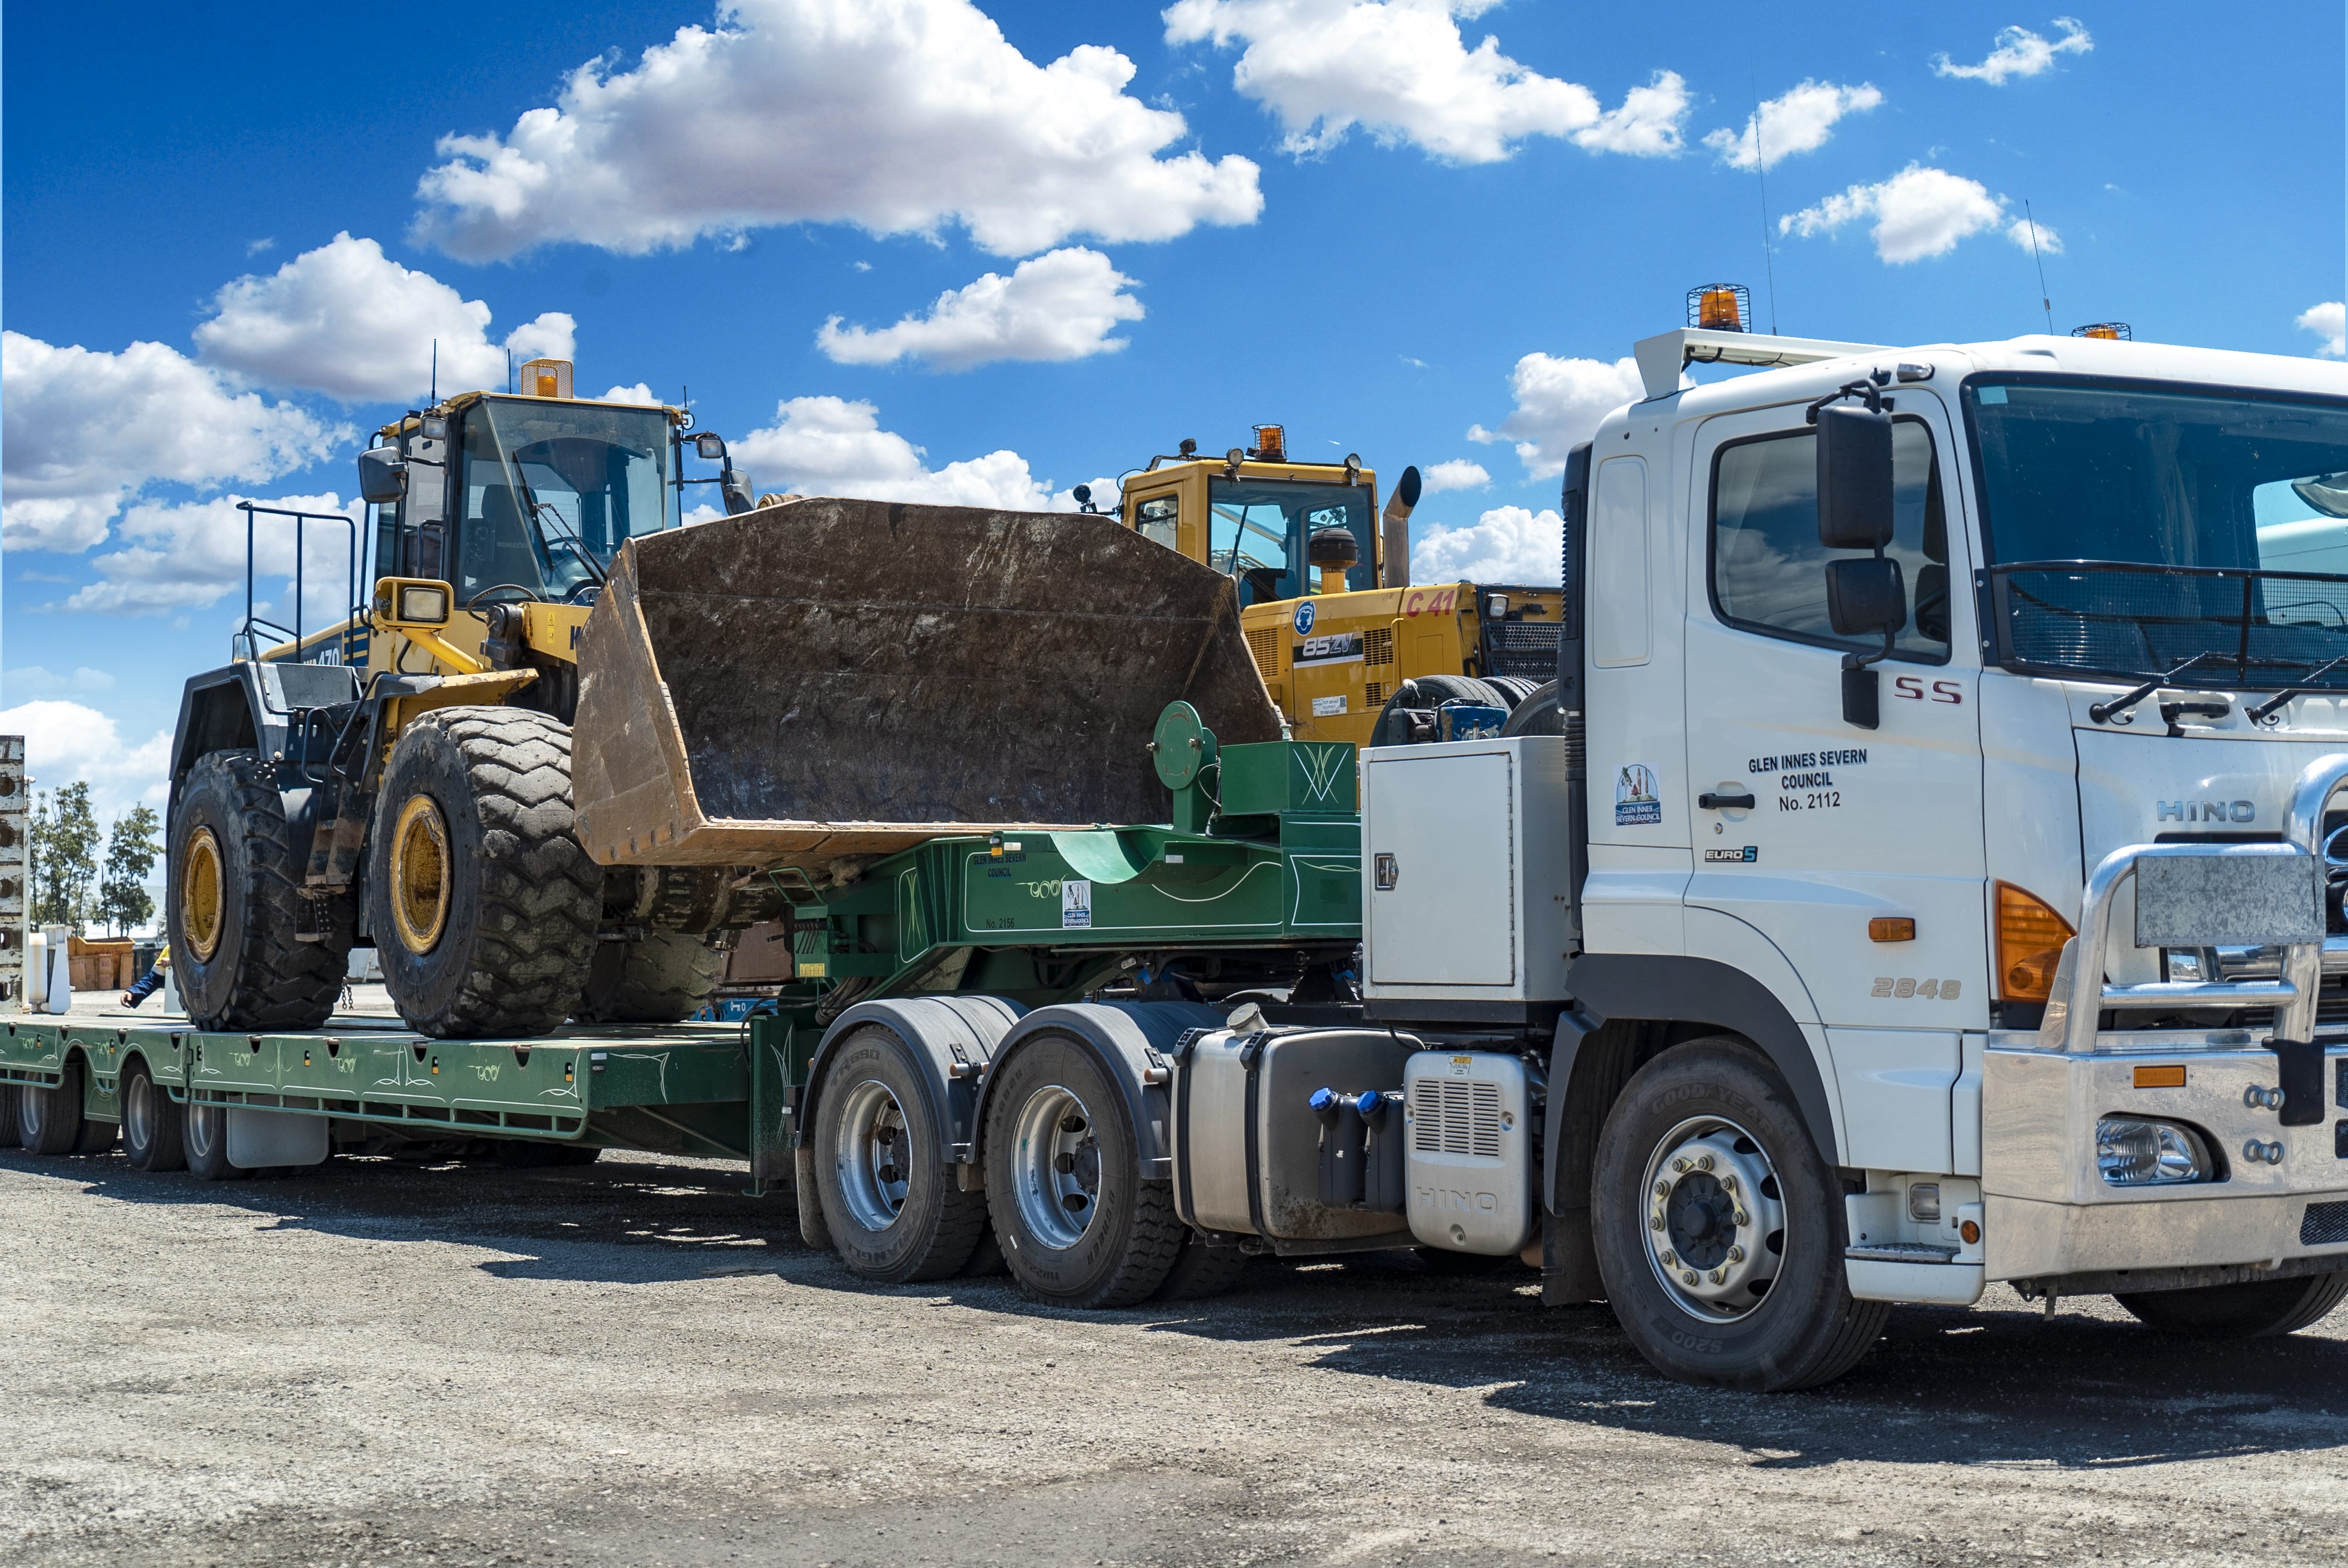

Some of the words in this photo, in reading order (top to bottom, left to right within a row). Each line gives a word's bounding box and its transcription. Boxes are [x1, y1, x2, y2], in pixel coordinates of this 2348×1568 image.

[1407, 592, 1424, 617] C
[1427, 590, 1455, 616] 41
[1302, 633, 1355, 657] 85ZV
[1749, 756, 1778, 773] GLEN
[1781, 752, 1816, 770] INNES
[1820, 749, 1868, 766] SEVERN
[1781, 772, 1833, 790] COUNCIL
[1779, 796, 1803, 812] No.
[1808, 792, 1841, 809] 2112
[2157, 800, 2256, 823] HINO
[1636, 813, 1660, 821] COUNCIL
[974, 854, 987, 866] GLEN
[1005, 852, 1026, 863] SEVERN
[988, 867, 1012, 878] COUNCIL
[986, 919, 997, 929] No.
[999, 917, 1015, 928] 2156
[1871, 977, 1961, 1000] 2848
[1416, 1187, 1497, 1214] HINO
[1671, 1330, 1723, 1353] S200
